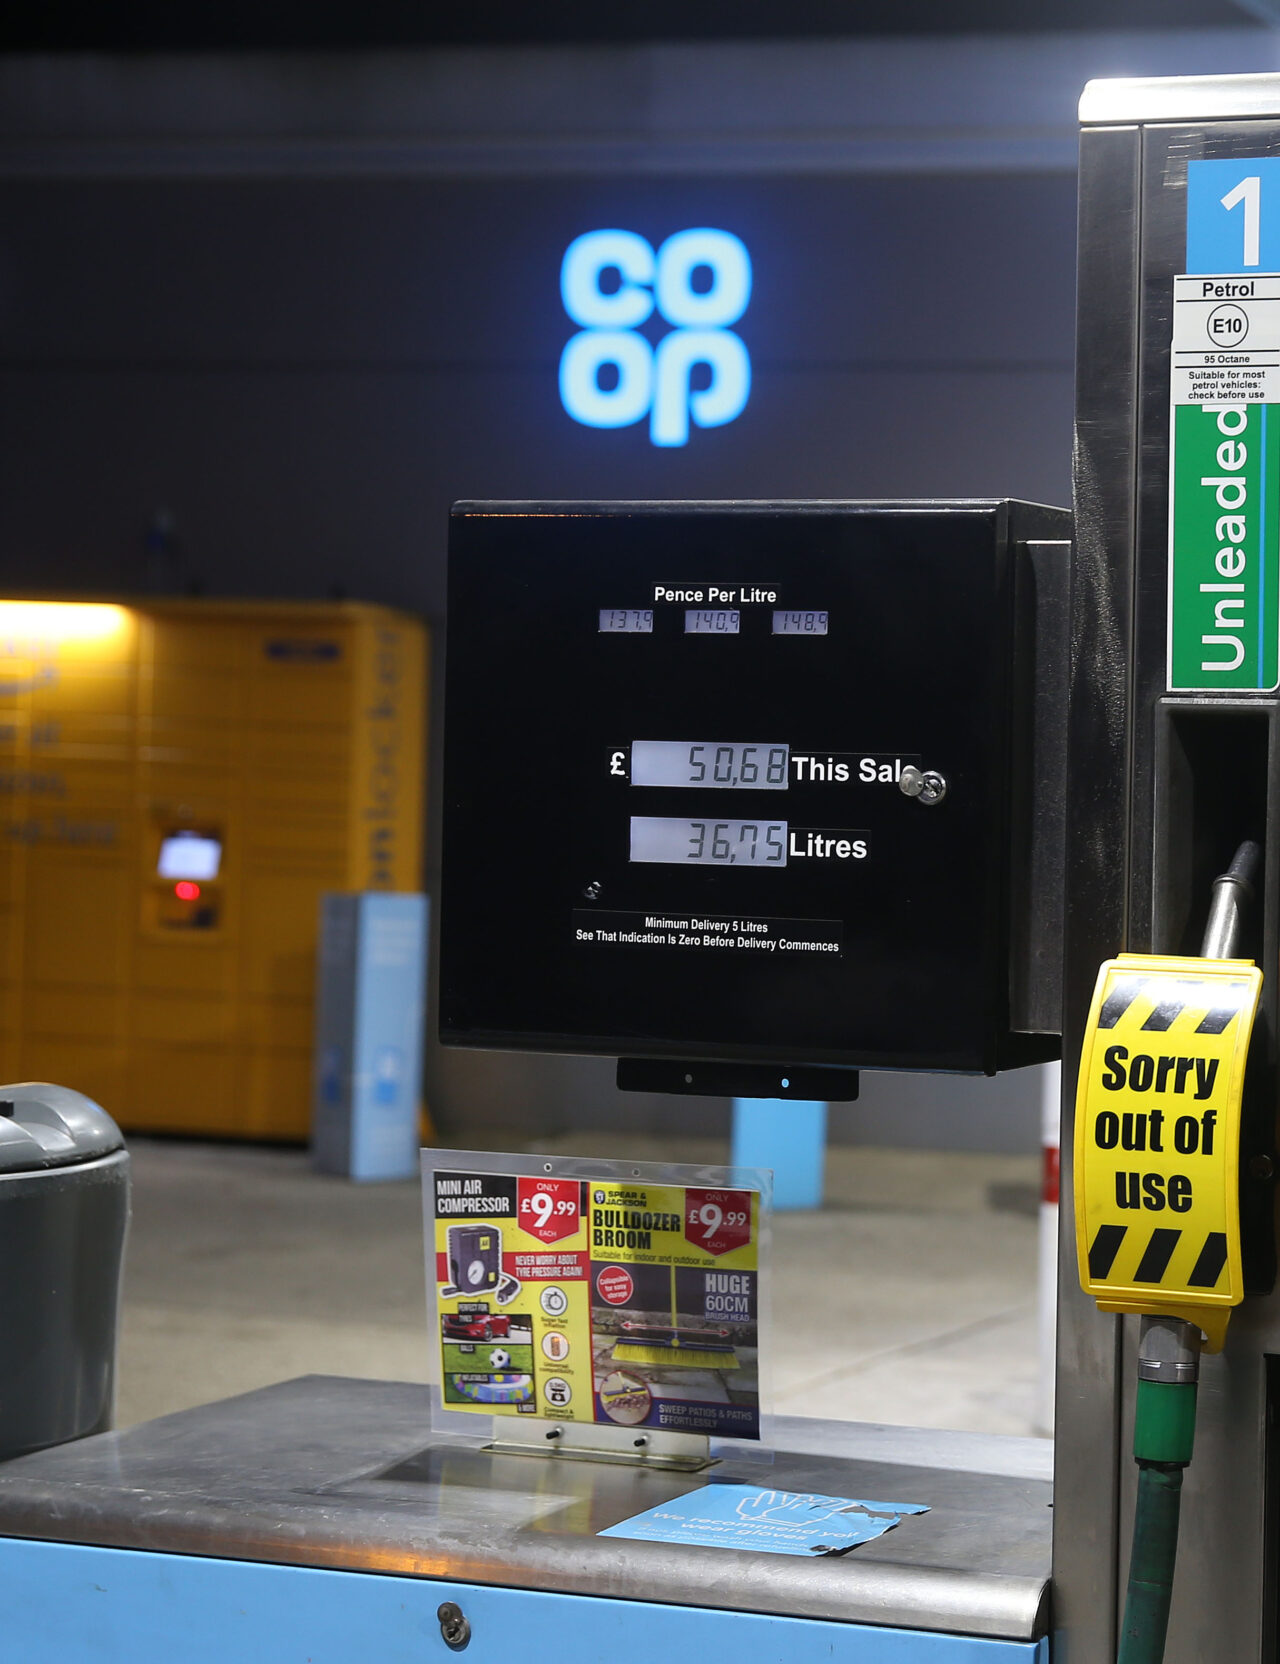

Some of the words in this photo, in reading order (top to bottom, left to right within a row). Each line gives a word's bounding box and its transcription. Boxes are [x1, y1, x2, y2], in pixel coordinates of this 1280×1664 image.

[1220, 176, 1261, 267] 1
[1202, 281, 1255, 297] Petrol
[1213, 318, 1242, 334] E10
[1204, 355, 1216, 364] 95
[1217, 354, 1250, 364] Octane
[1188, 370, 1225, 380] Suitable
[1227, 370, 1241, 379] for
[1242, 370, 1266, 379] most
[1192, 381, 1218, 391] petrol
[1220, 380, 1261, 389] vehicles:
[1188, 391, 1215, 400] check
[1217, 390, 1246, 400] before
[1199, 403, 1249, 672] Unleaded
[654, 586, 704, 602] Pence
[708, 587, 736, 603] Per
[740, 587, 777, 603] Litre
[791, 756, 849, 783] This
[858, 757, 901, 783] Sal
[789, 832, 868, 859] Litres
[645, 916, 689, 929] Minimum
[691, 918, 730, 933] Delivery
[732, 921, 739, 932] 5
[740, 921, 769, 933] Litres
[576, 928, 594, 941] See
[596, 930, 617, 942] That
[619, 931, 666, 944] Indication
[668, 933, 677, 945] Is
[678, 934, 701, 946] Zero
[703, 935, 735, 947] Before
[737, 936, 777, 952] Delivery
[779, 938, 840, 952] Commences
[1101, 1045, 1220, 1101] Sorry
[1094, 1109, 1165, 1153] out
[1174, 1109, 1218, 1156] of
[437, 1180, 462, 1195] MINI
[463, 1179, 482, 1195] AIR
[536, 1182, 559, 1192] ONLY
[607, 1190, 638, 1200] SPEAR
[639, 1192, 647, 1200] &
[1115, 1171, 1193, 1213] use
[437, 1197, 510, 1214] COMPRESSOR
[606, 1198, 647, 1208] JACKSON
[705, 1193, 729, 1202] ONLY
[521, 1192, 576, 1228] £9.99
[593, 1209, 681, 1233] BULLDOZER
[688, 1203, 747, 1239] £9.99
[538, 1229, 557, 1237] EACH
[593, 1229, 652, 1250] BROOM
[707, 1241, 726, 1249] EACH
[515, 1255, 535, 1266] NEVER
[558, 1254, 578, 1265] ABOUT
[593, 1250, 621, 1260] Suitable
[623, 1252, 633, 1260] for
[634, 1253, 657, 1262] indoor
[658, 1255, 672, 1263] and
[673, 1256, 700, 1265] outdoor
[702, 1258, 716, 1266] use
[515, 1267, 531, 1278] TYRE
[531, 1267, 562, 1278] PRESSURE
[705, 1273, 750, 1295] HUGE
[705, 1295, 749, 1313] 60CM
[705, 1312, 729, 1321] BRUSH
[730, 1313, 750, 1322] HEAD
[659, 1404, 688, 1415] SWEEP
[688, 1407, 717, 1418] PATIOS
[718, 1409, 725, 1418] &
[726, 1410, 753, 1421] PATHS
[659, 1414, 719, 1428] EFFORTLESSLY
[653, 1512, 686, 1521] We
[690, 1517, 819, 1535] recommend
[681, 1523, 735, 1533] wear
[734, 1529, 808, 1540] gloves
